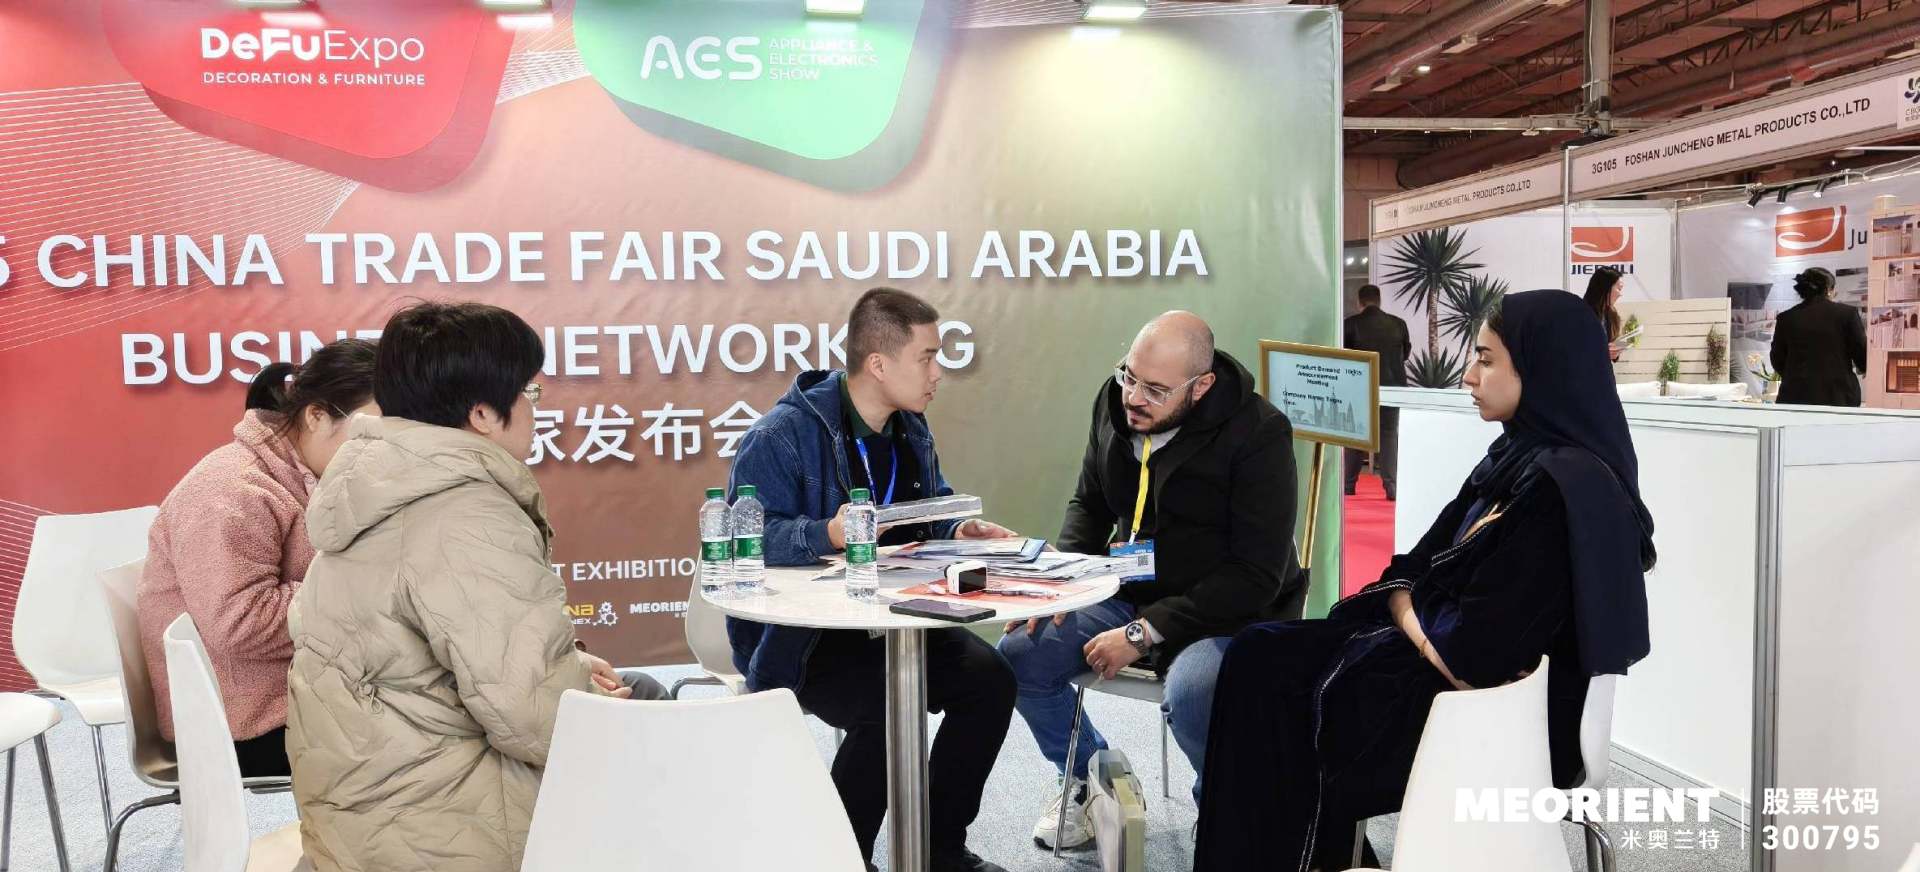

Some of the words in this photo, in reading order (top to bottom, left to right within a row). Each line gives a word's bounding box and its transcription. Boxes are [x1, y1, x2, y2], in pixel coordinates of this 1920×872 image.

[201, 28, 425, 68] DeFuExpo
[768, 38, 860, 51] APPLIANCE
[862, 38, 875, 51] &
[768, 54, 879, 66] ELECTRONICS
[203, 72, 312, 85] DECORATION
[319, 73, 329, 85] &
[334, 73, 425, 86] FURNITURE
[768, 68, 821, 80] SHOW
[1591, 158, 1617, 175] 3G105
[1625, 149, 1660, 166] FOSHAN
[1662, 136, 1714, 158] JUNCHENG
[1716, 128, 1753, 145] METAL
[1754, 110, 1817, 136] PRODUCTS
[1820, 97, 1870, 122] CO.,LTD
[1453, 194, 1471, 206] METAL
[1472, 185, 1505, 200] PRODUCTS
[37, 234, 283, 288] CHINA
[305, 231, 545, 285] TRADE
[569, 230, 725, 282] FAIR
[745, 229, 948, 281] SAUDI
[969, 228, 1208, 279] ARABIA
[573, 557, 697, 581] EXHIBITIO
[629, 601, 689, 614] MEORIEN
